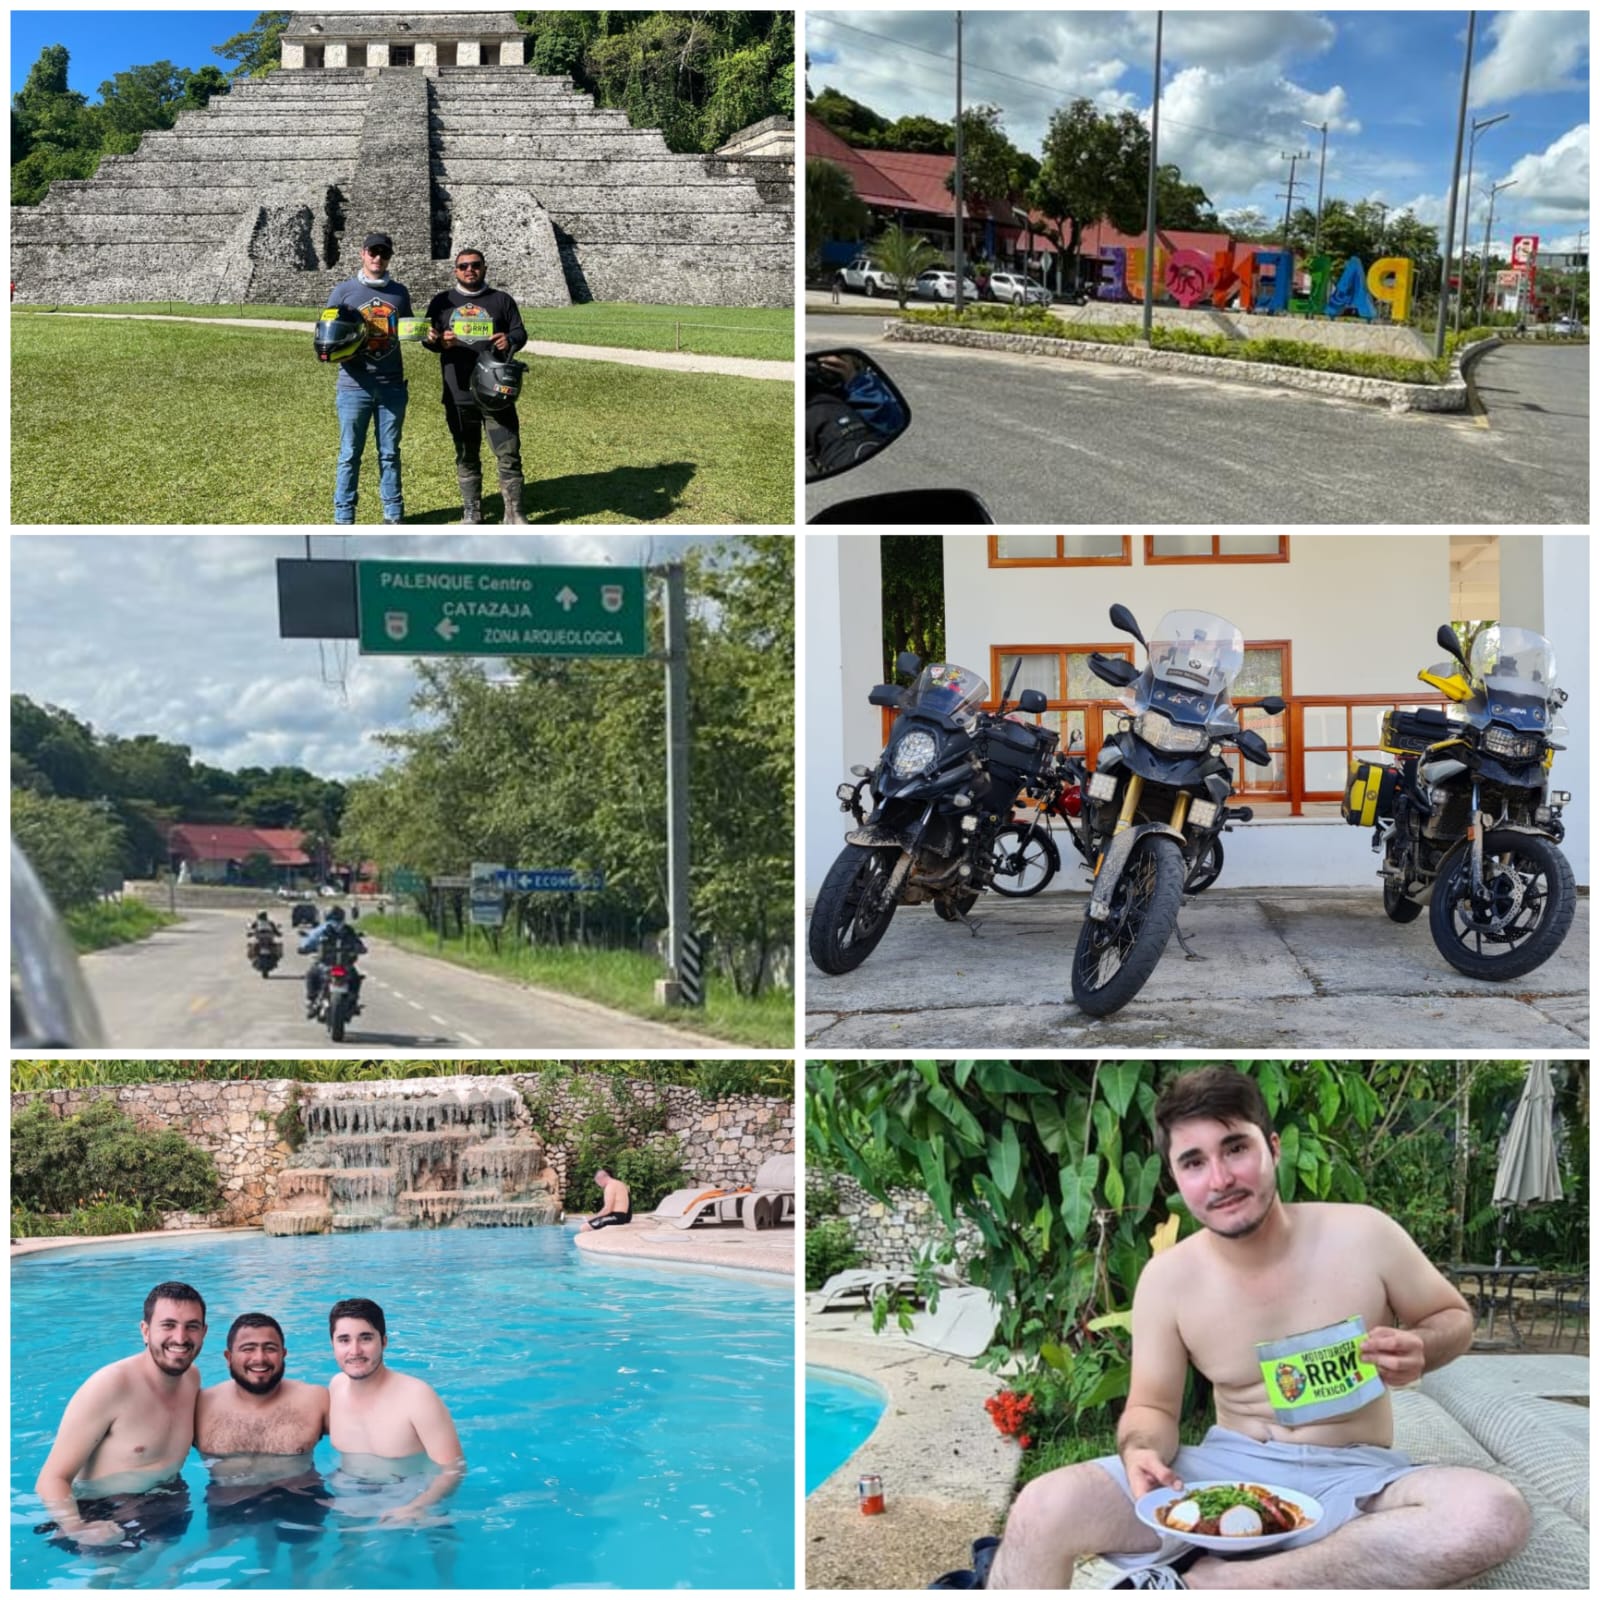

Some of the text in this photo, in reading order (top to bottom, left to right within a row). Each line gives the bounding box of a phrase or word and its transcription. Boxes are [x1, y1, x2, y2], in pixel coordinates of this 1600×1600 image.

[472, 325, 488, 333] RRM
[380, 572, 533, 592] PALENQUE Centro
[442, 602, 533, 618] CATAZAJA
[483, 628, 624, 645] ZONA ARQUEOLOGICA
[1301, 1340, 1356, 1362] MOTOTURISTA
[1305, 1351, 1358, 1387] RRM
